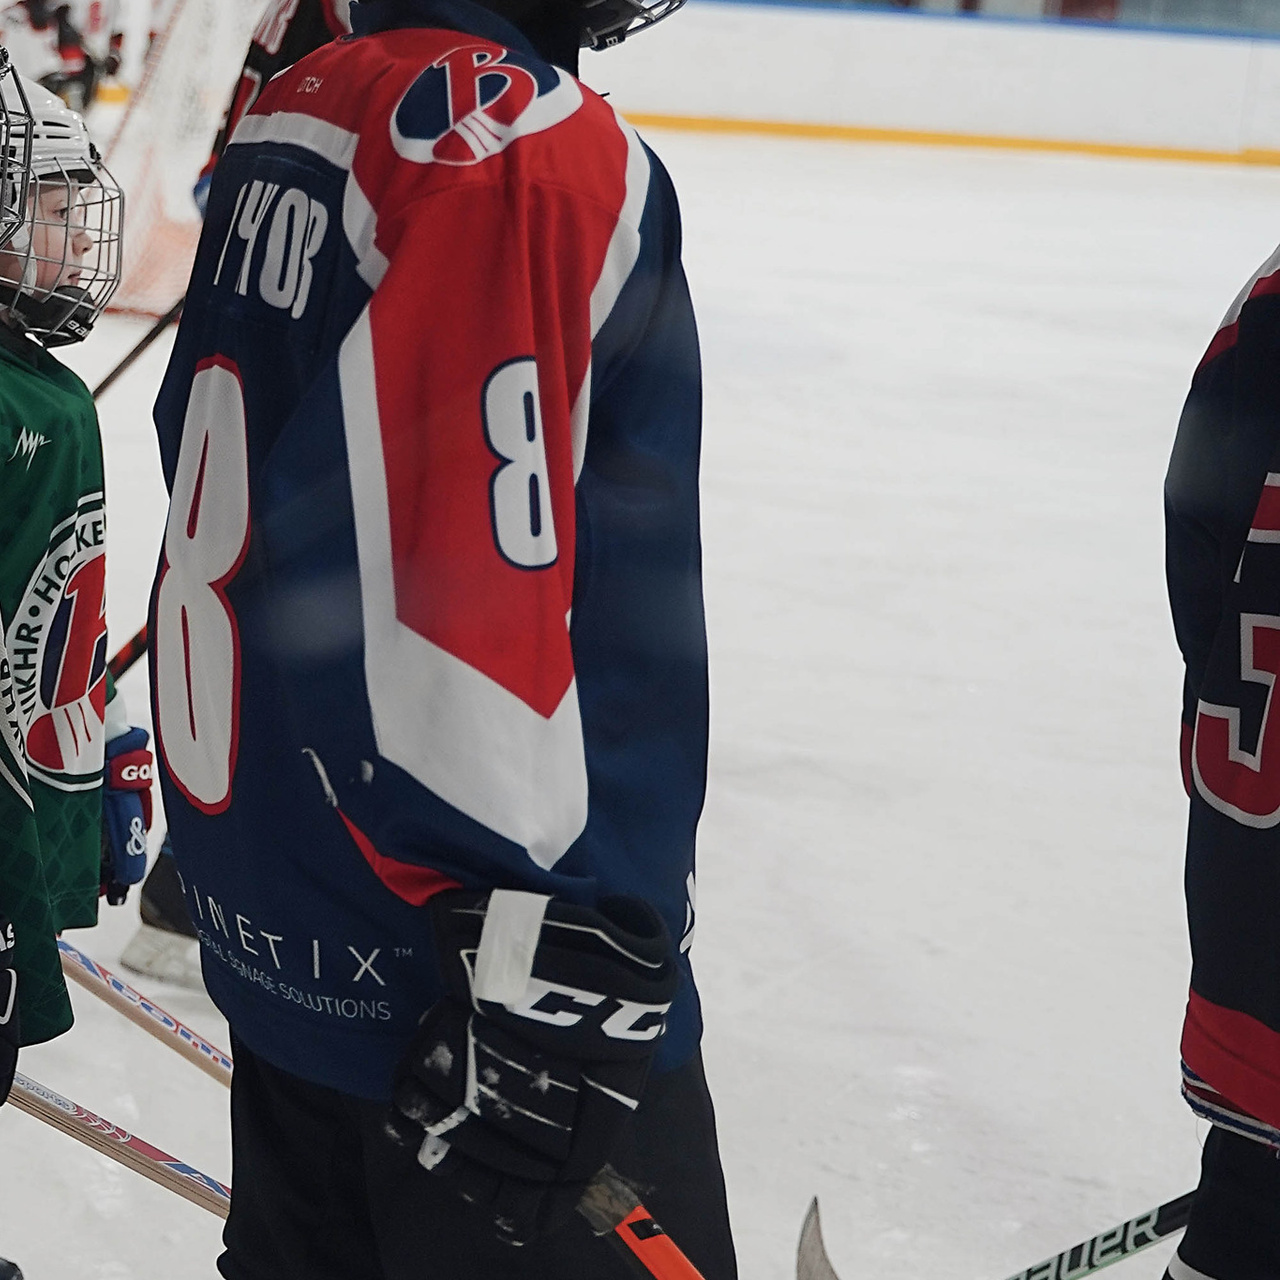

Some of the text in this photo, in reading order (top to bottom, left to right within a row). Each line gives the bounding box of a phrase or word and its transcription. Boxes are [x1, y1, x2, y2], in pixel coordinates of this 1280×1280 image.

[481, 355, 559, 572] 8
[156, 353, 252, 816] 8
[278, 982, 392, 1021] SOLUTIONS
[503, 976, 673, 1041] CC
